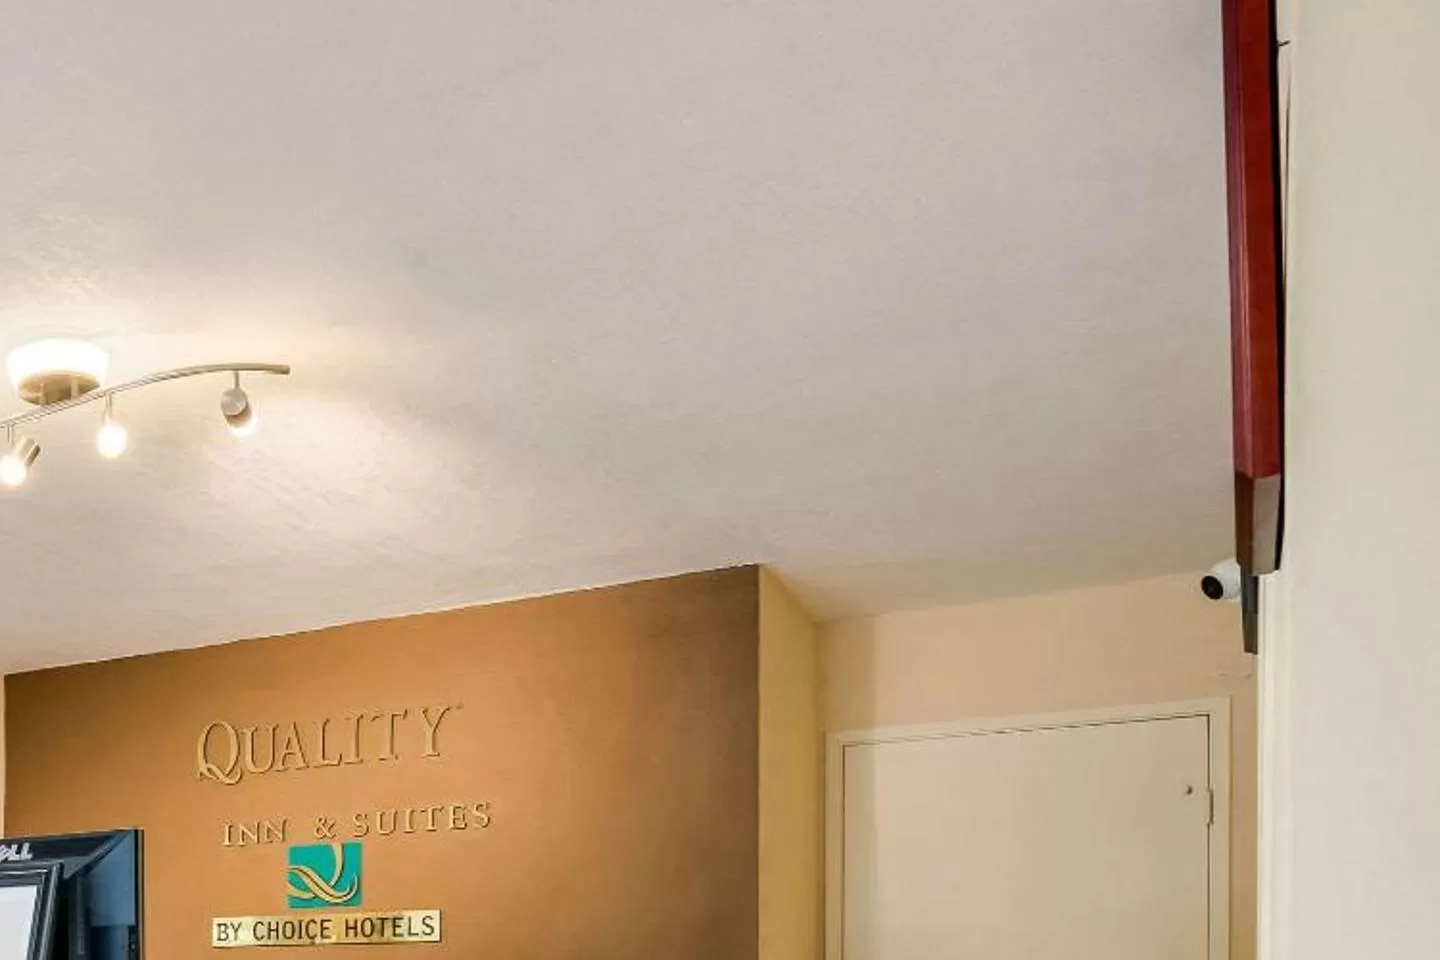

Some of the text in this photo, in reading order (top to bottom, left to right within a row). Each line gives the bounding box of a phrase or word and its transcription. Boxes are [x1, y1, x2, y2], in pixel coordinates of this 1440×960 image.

[197, 705, 452, 785] QUALITY
[222, 800, 492, 848] INN & SUITES
[215, 915, 435, 942] BY CHOICE HOTELS
